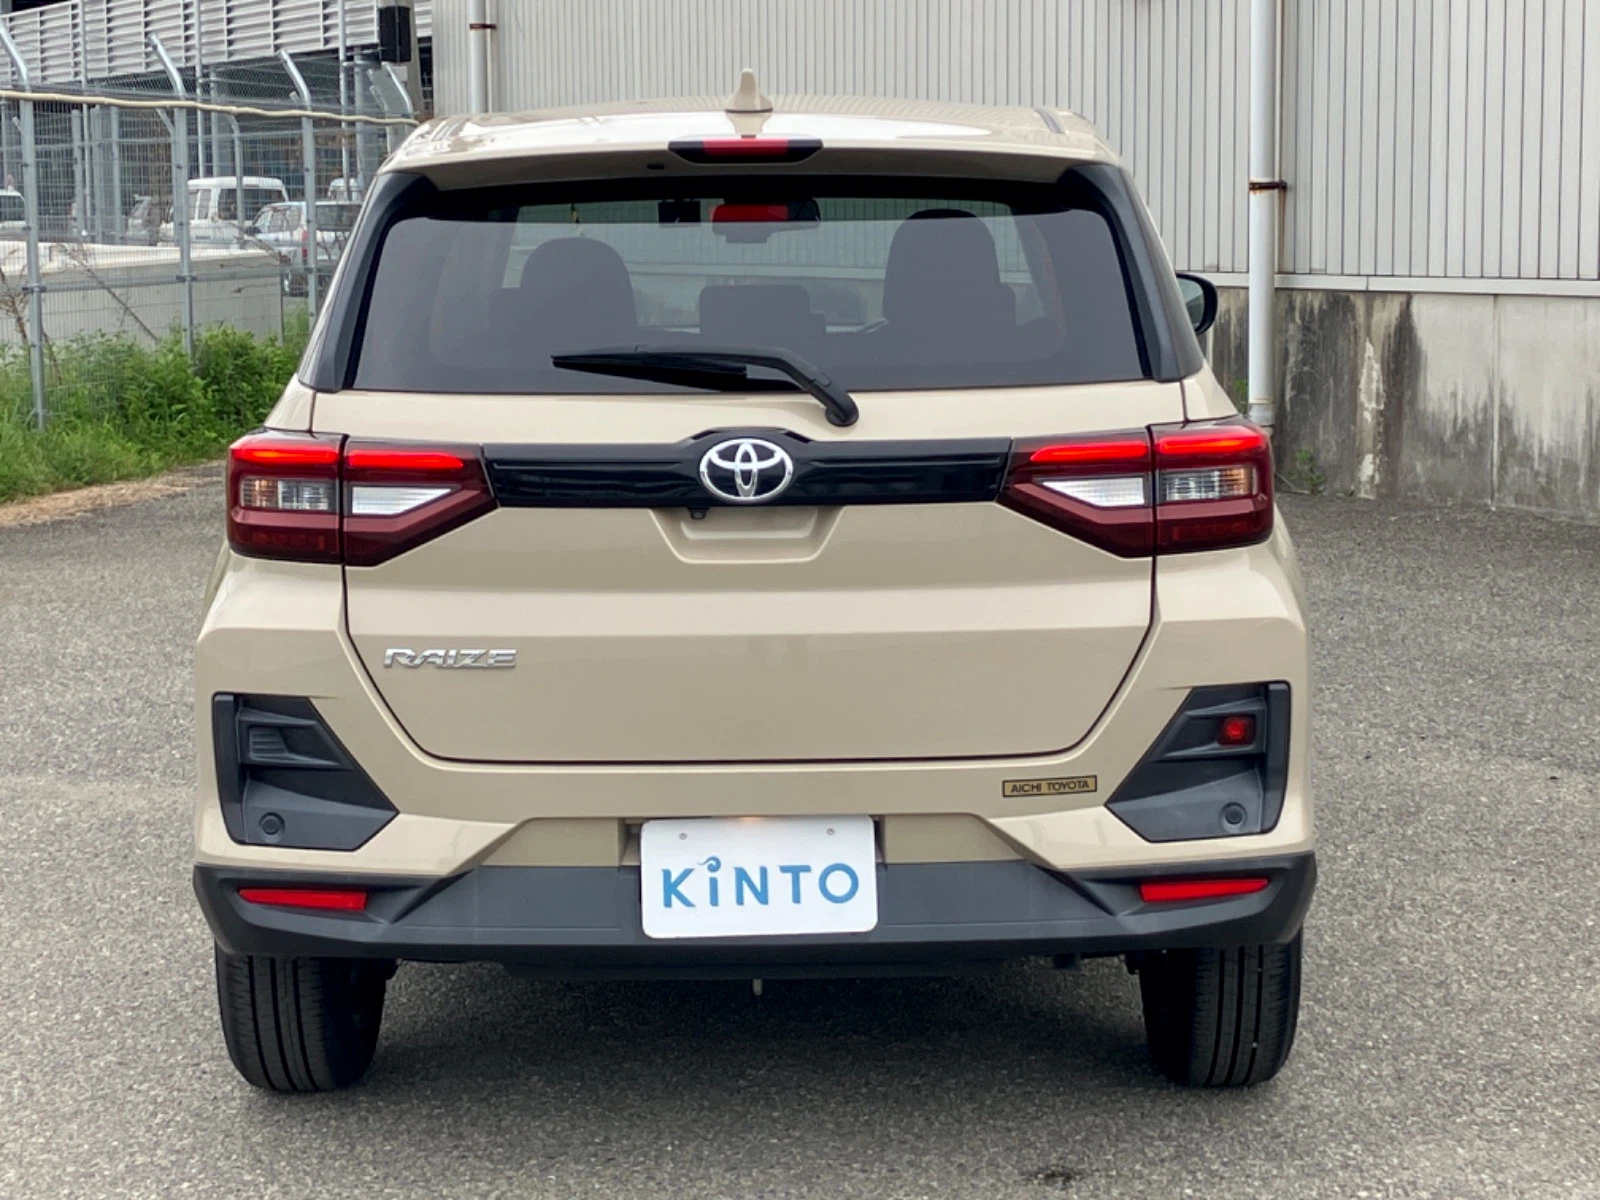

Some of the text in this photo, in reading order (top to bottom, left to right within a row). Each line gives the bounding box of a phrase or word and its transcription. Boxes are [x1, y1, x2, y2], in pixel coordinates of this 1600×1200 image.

[384, 648, 517, 669] RAIZE
[1010, 780, 1090, 793] AICHI TOYOTA
